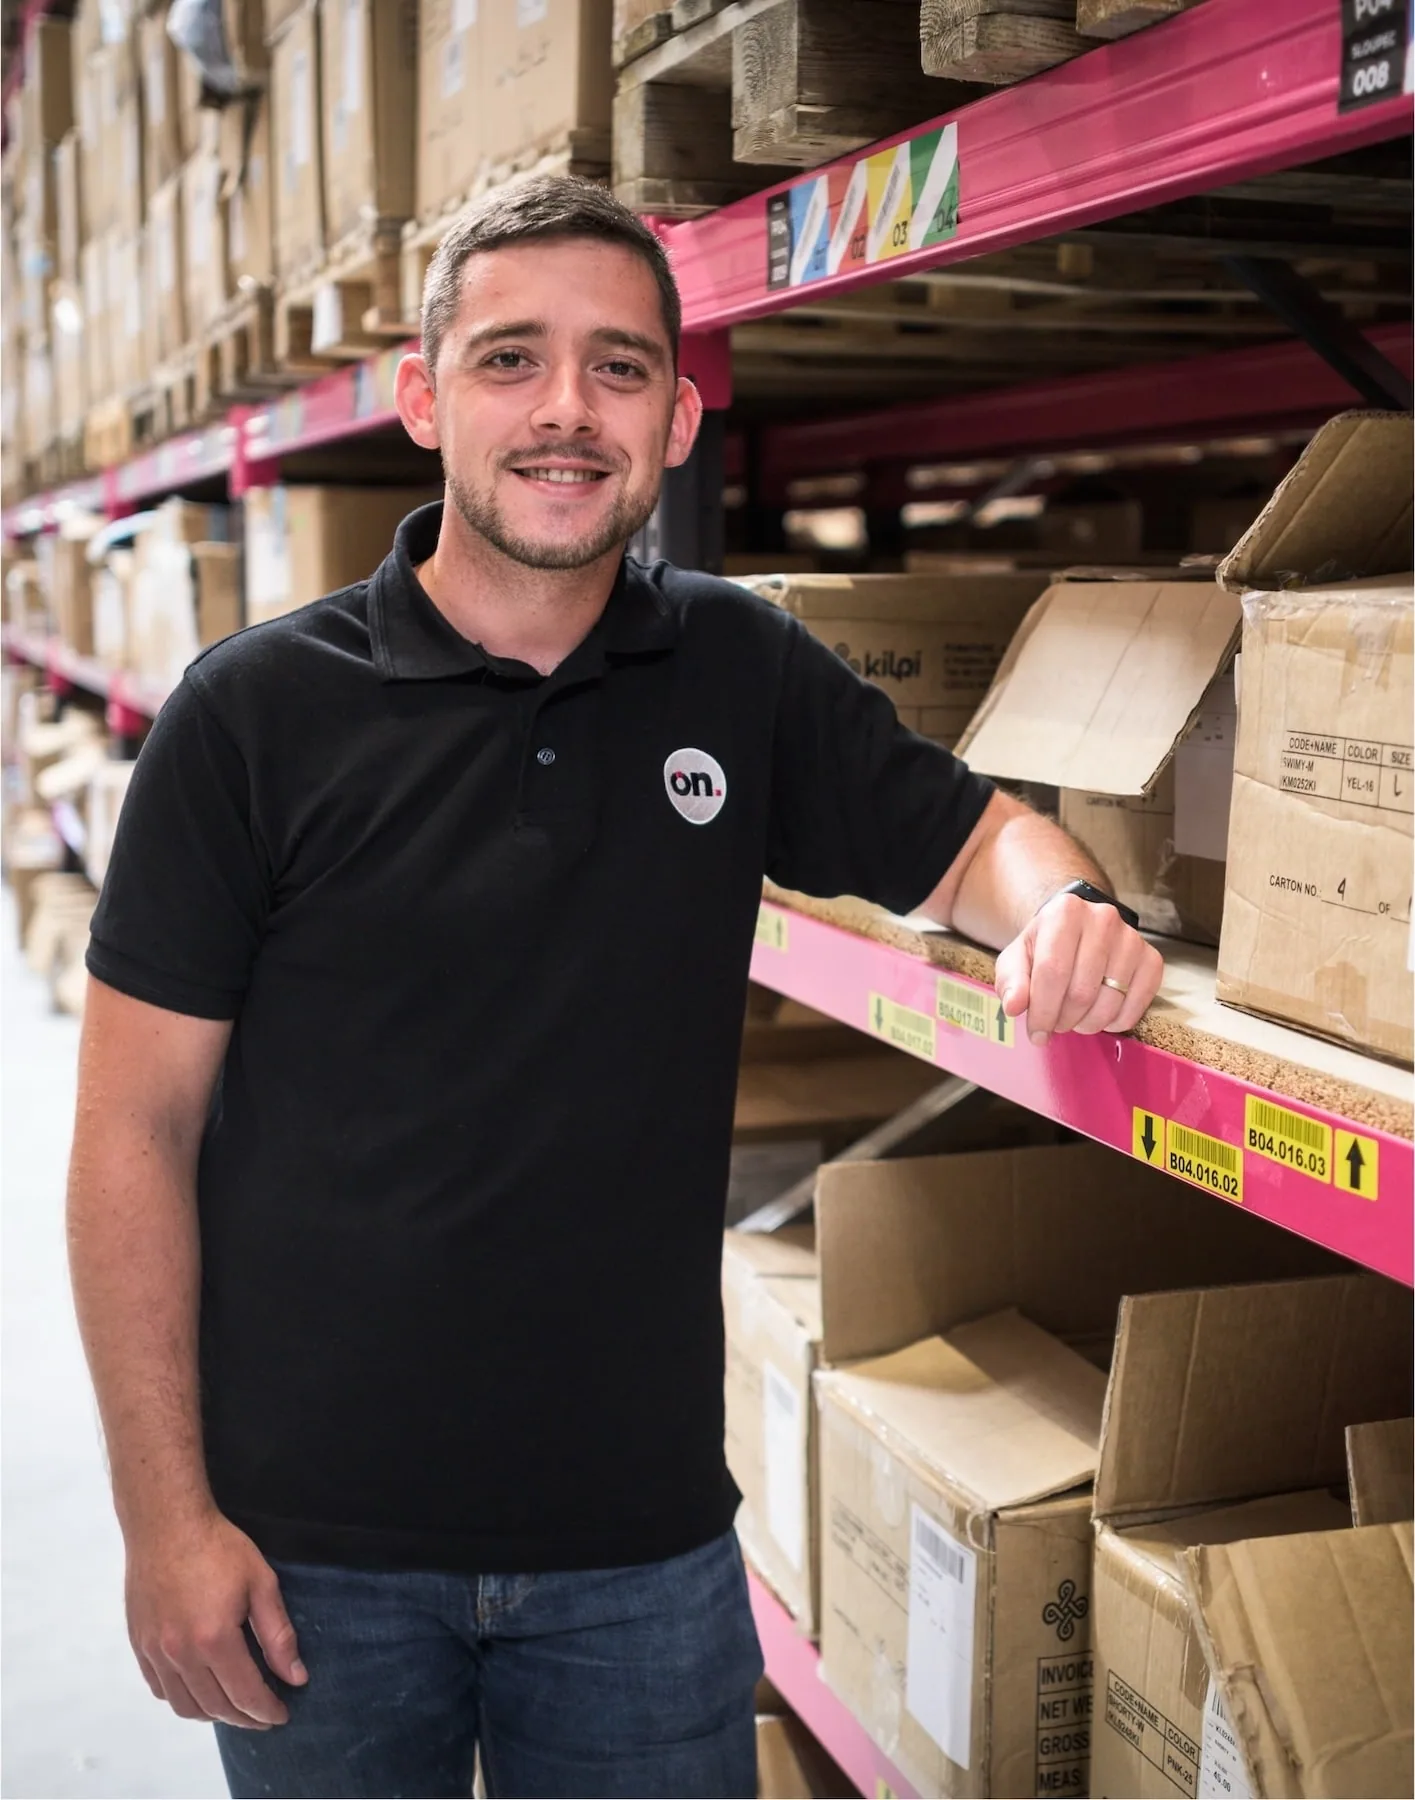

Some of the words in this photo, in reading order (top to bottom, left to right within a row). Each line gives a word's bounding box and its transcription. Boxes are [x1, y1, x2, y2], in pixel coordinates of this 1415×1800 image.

[1353, 61, 1390, 97] 008
[892, 220, 908, 248] 03
[865, 651, 922, 683] kilpi
[1289, 737, 1337, 755] CODE+NAME
[1347, 745, 1379, 761] COLOR
[1391, 751, 1413, 766] SIZE
[1346, 776, 1375, 792] YEL-16
[1269, 874, 1303, 893] CARTON
[1336, 877, 1347, 901] 4
[1378, 901, 1391, 915] OF
[939, 1001, 986, 1034] B04.017.03
[1249, 1127, 1326, 1177] B04.016.03
[1169, 1151, 1239, 1197] B04.016.02
[1041, 1700, 1068, 1720] NET
[1073, 1695, 1094, 1716] WE
[1114, 1681, 1160, 1727] CODE+NAME
[1168, 1727, 1197, 1759] COLOR
[1040, 1731, 1089, 1755] GROSS
[1167, 1755, 1194, 1786] PNK-25
[1213, 1772, 1232, 1792] 45.00
